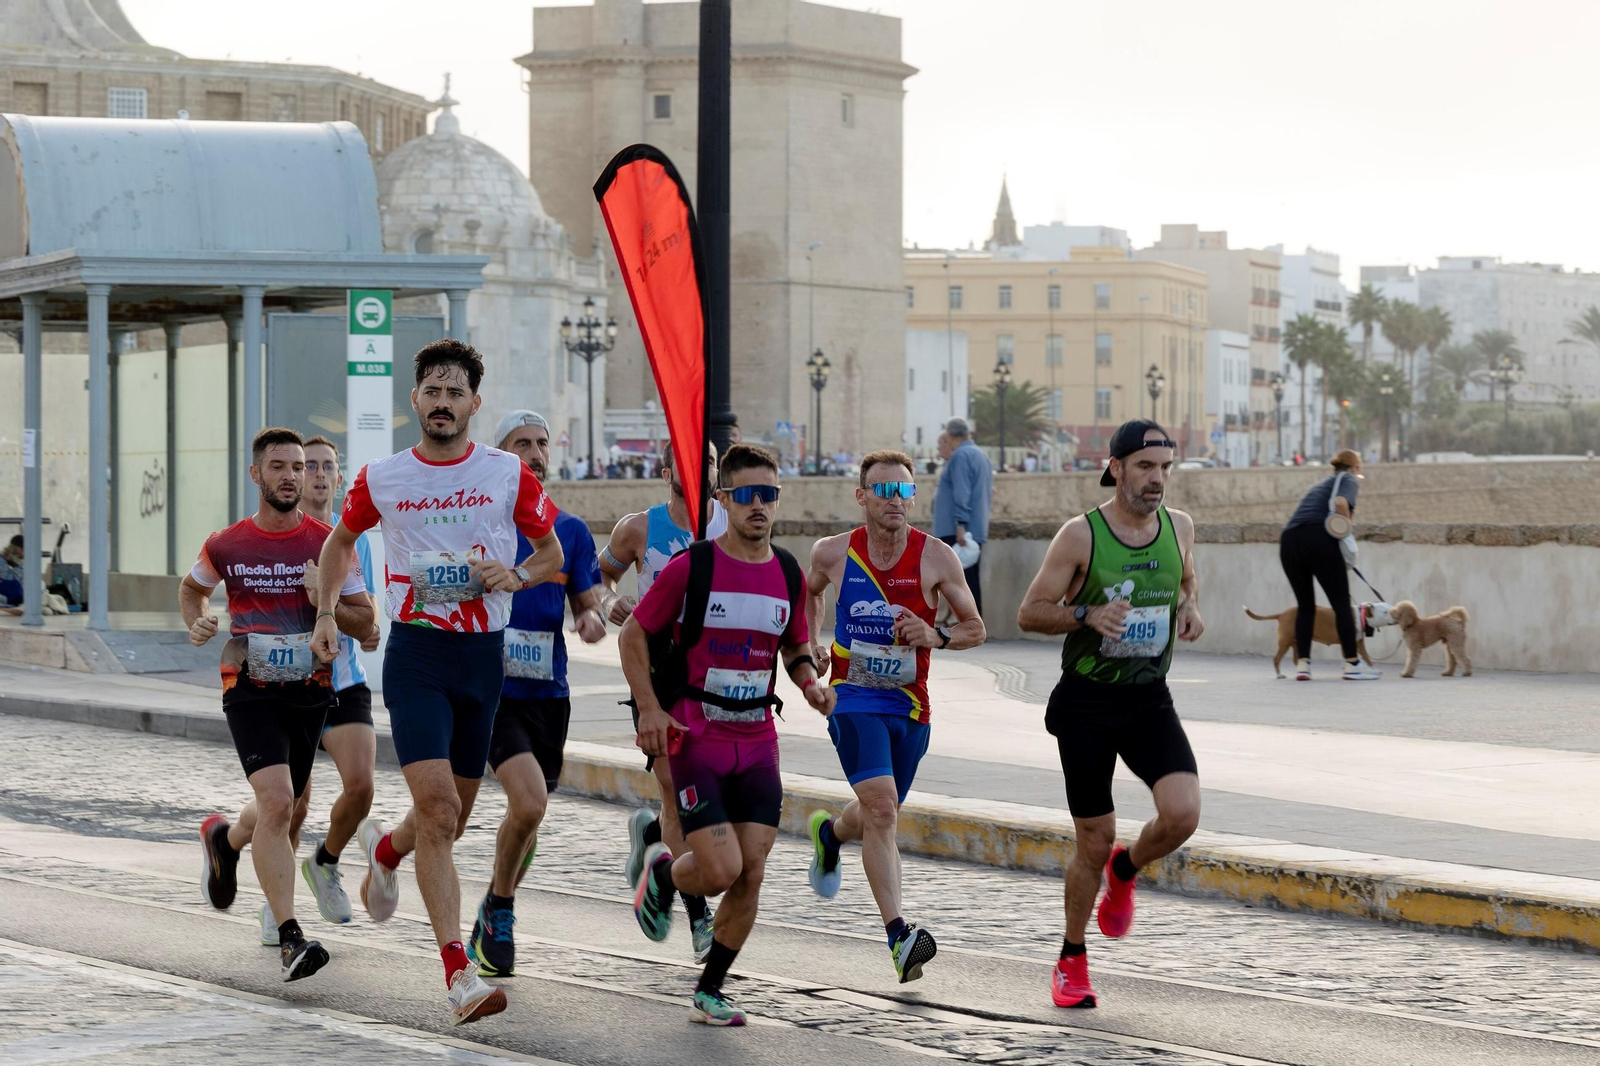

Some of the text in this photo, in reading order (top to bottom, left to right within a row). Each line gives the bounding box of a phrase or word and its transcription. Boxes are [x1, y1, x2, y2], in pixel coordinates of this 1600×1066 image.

[365, 343, 376, 354] A
[396, 488, 493, 512] maratón
[424, 515, 468, 524] JEREZ
[243, 577, 273, 587] Ciudad
[425, 566, 470, 585] 1258
[268, 648, 294, 666] 471
[508, 643, 542, 662] 1096
[865, 656, 902, 675] 1572
